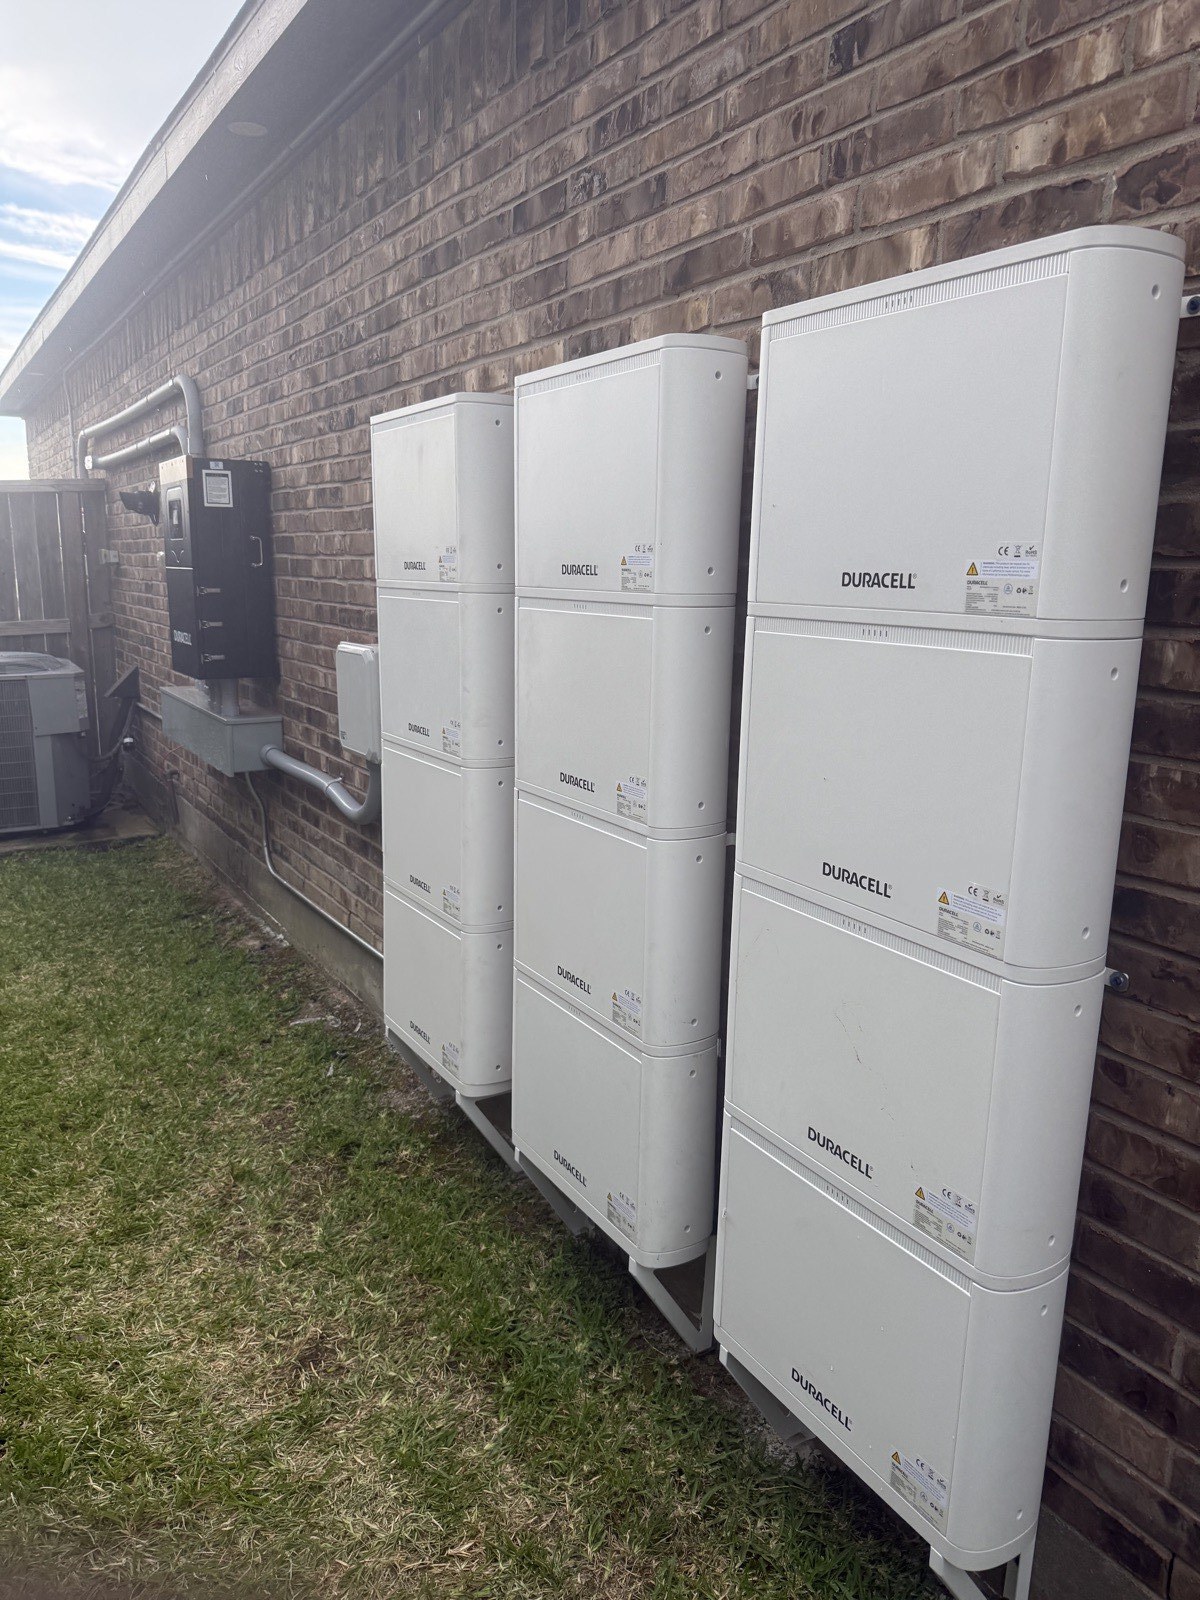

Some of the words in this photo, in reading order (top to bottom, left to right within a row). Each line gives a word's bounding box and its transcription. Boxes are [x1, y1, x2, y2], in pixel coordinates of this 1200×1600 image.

[562, 564, 598, 576] DURACELL
[842, 572, 916, 589] DURACELL
[560, 772, 595, 793] DURACELL
[822, 862, 891, 898] DURACELL
[557, 965, 591, 995] DURACELL
[808, 1126, 872, 1179] DURACELL
[792, 1368, 851, 1432] DURACELL
